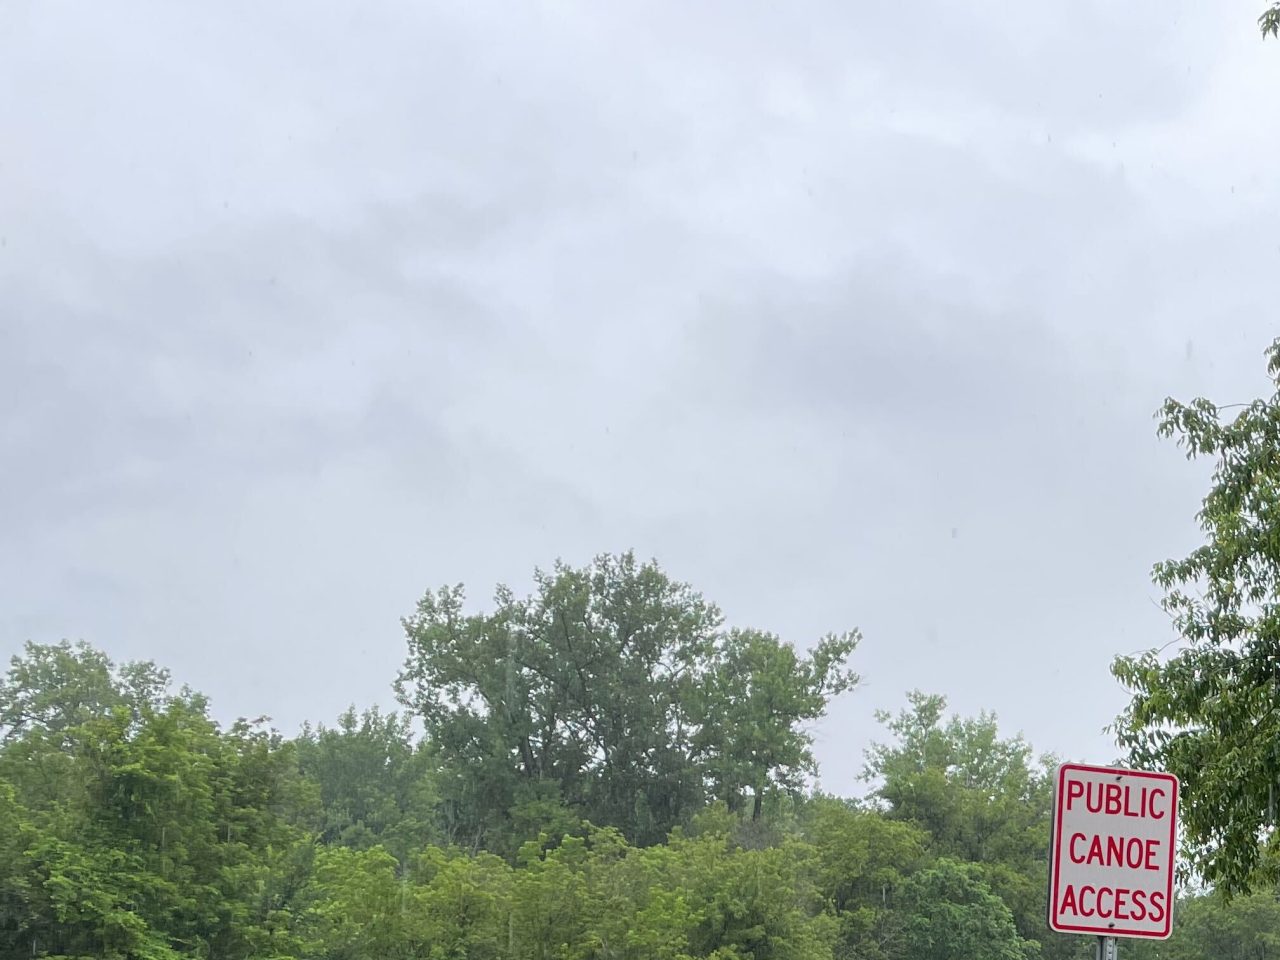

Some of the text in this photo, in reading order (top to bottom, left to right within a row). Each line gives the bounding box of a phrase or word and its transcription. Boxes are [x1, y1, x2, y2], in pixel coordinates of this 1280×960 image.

[1066, 780, 1166, 820] PUBLIC
[1069, 832, 1161, 871] CANOE
[1059, 884, 1165, 922] ACCESS
